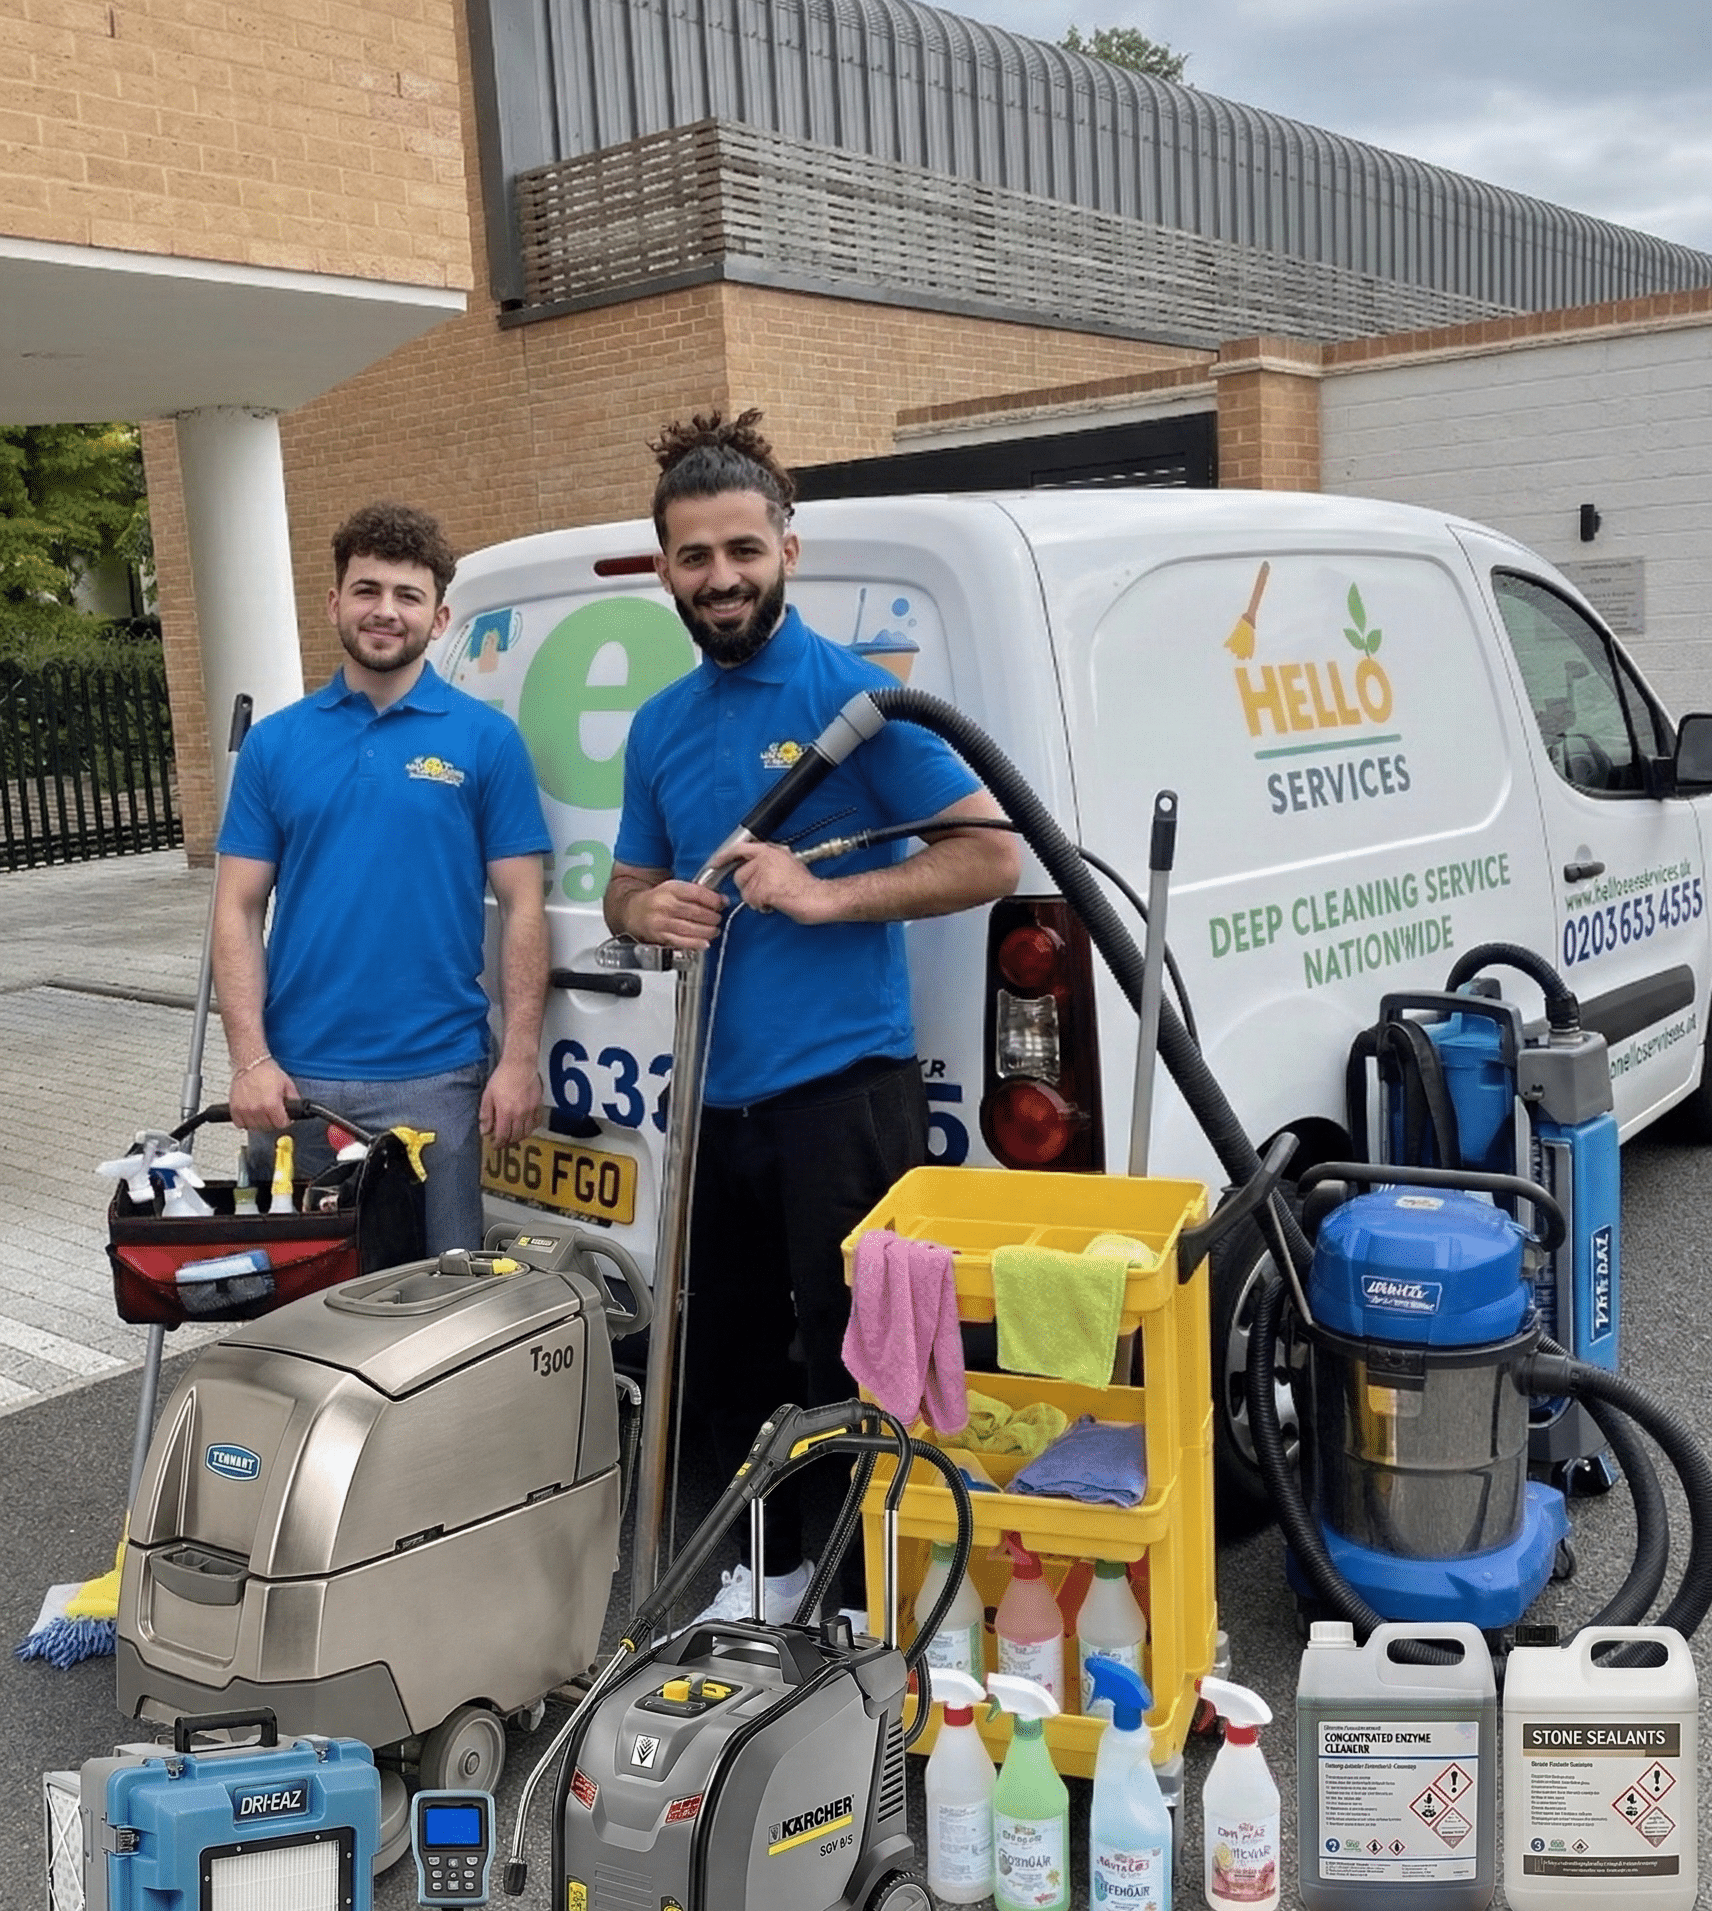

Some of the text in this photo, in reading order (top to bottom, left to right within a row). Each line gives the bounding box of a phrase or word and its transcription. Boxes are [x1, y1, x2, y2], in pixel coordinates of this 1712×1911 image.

[1234, 658, 1394, 737] HELLO
[1266, 754, 1412, 815] SERVICES
[1209, 852, 1512, 958] DEEP CLEANING SERVICE
[1302, 914, 1454, 990] NATIONWIDE
[551, 1150, 620, 1208] FGO
[530, 1345, 574, 1377] T300
[1395, 1733, 1431, 1743] ENZYME
[1532, 1730, 1666, 1745] STONE SEALANTS
